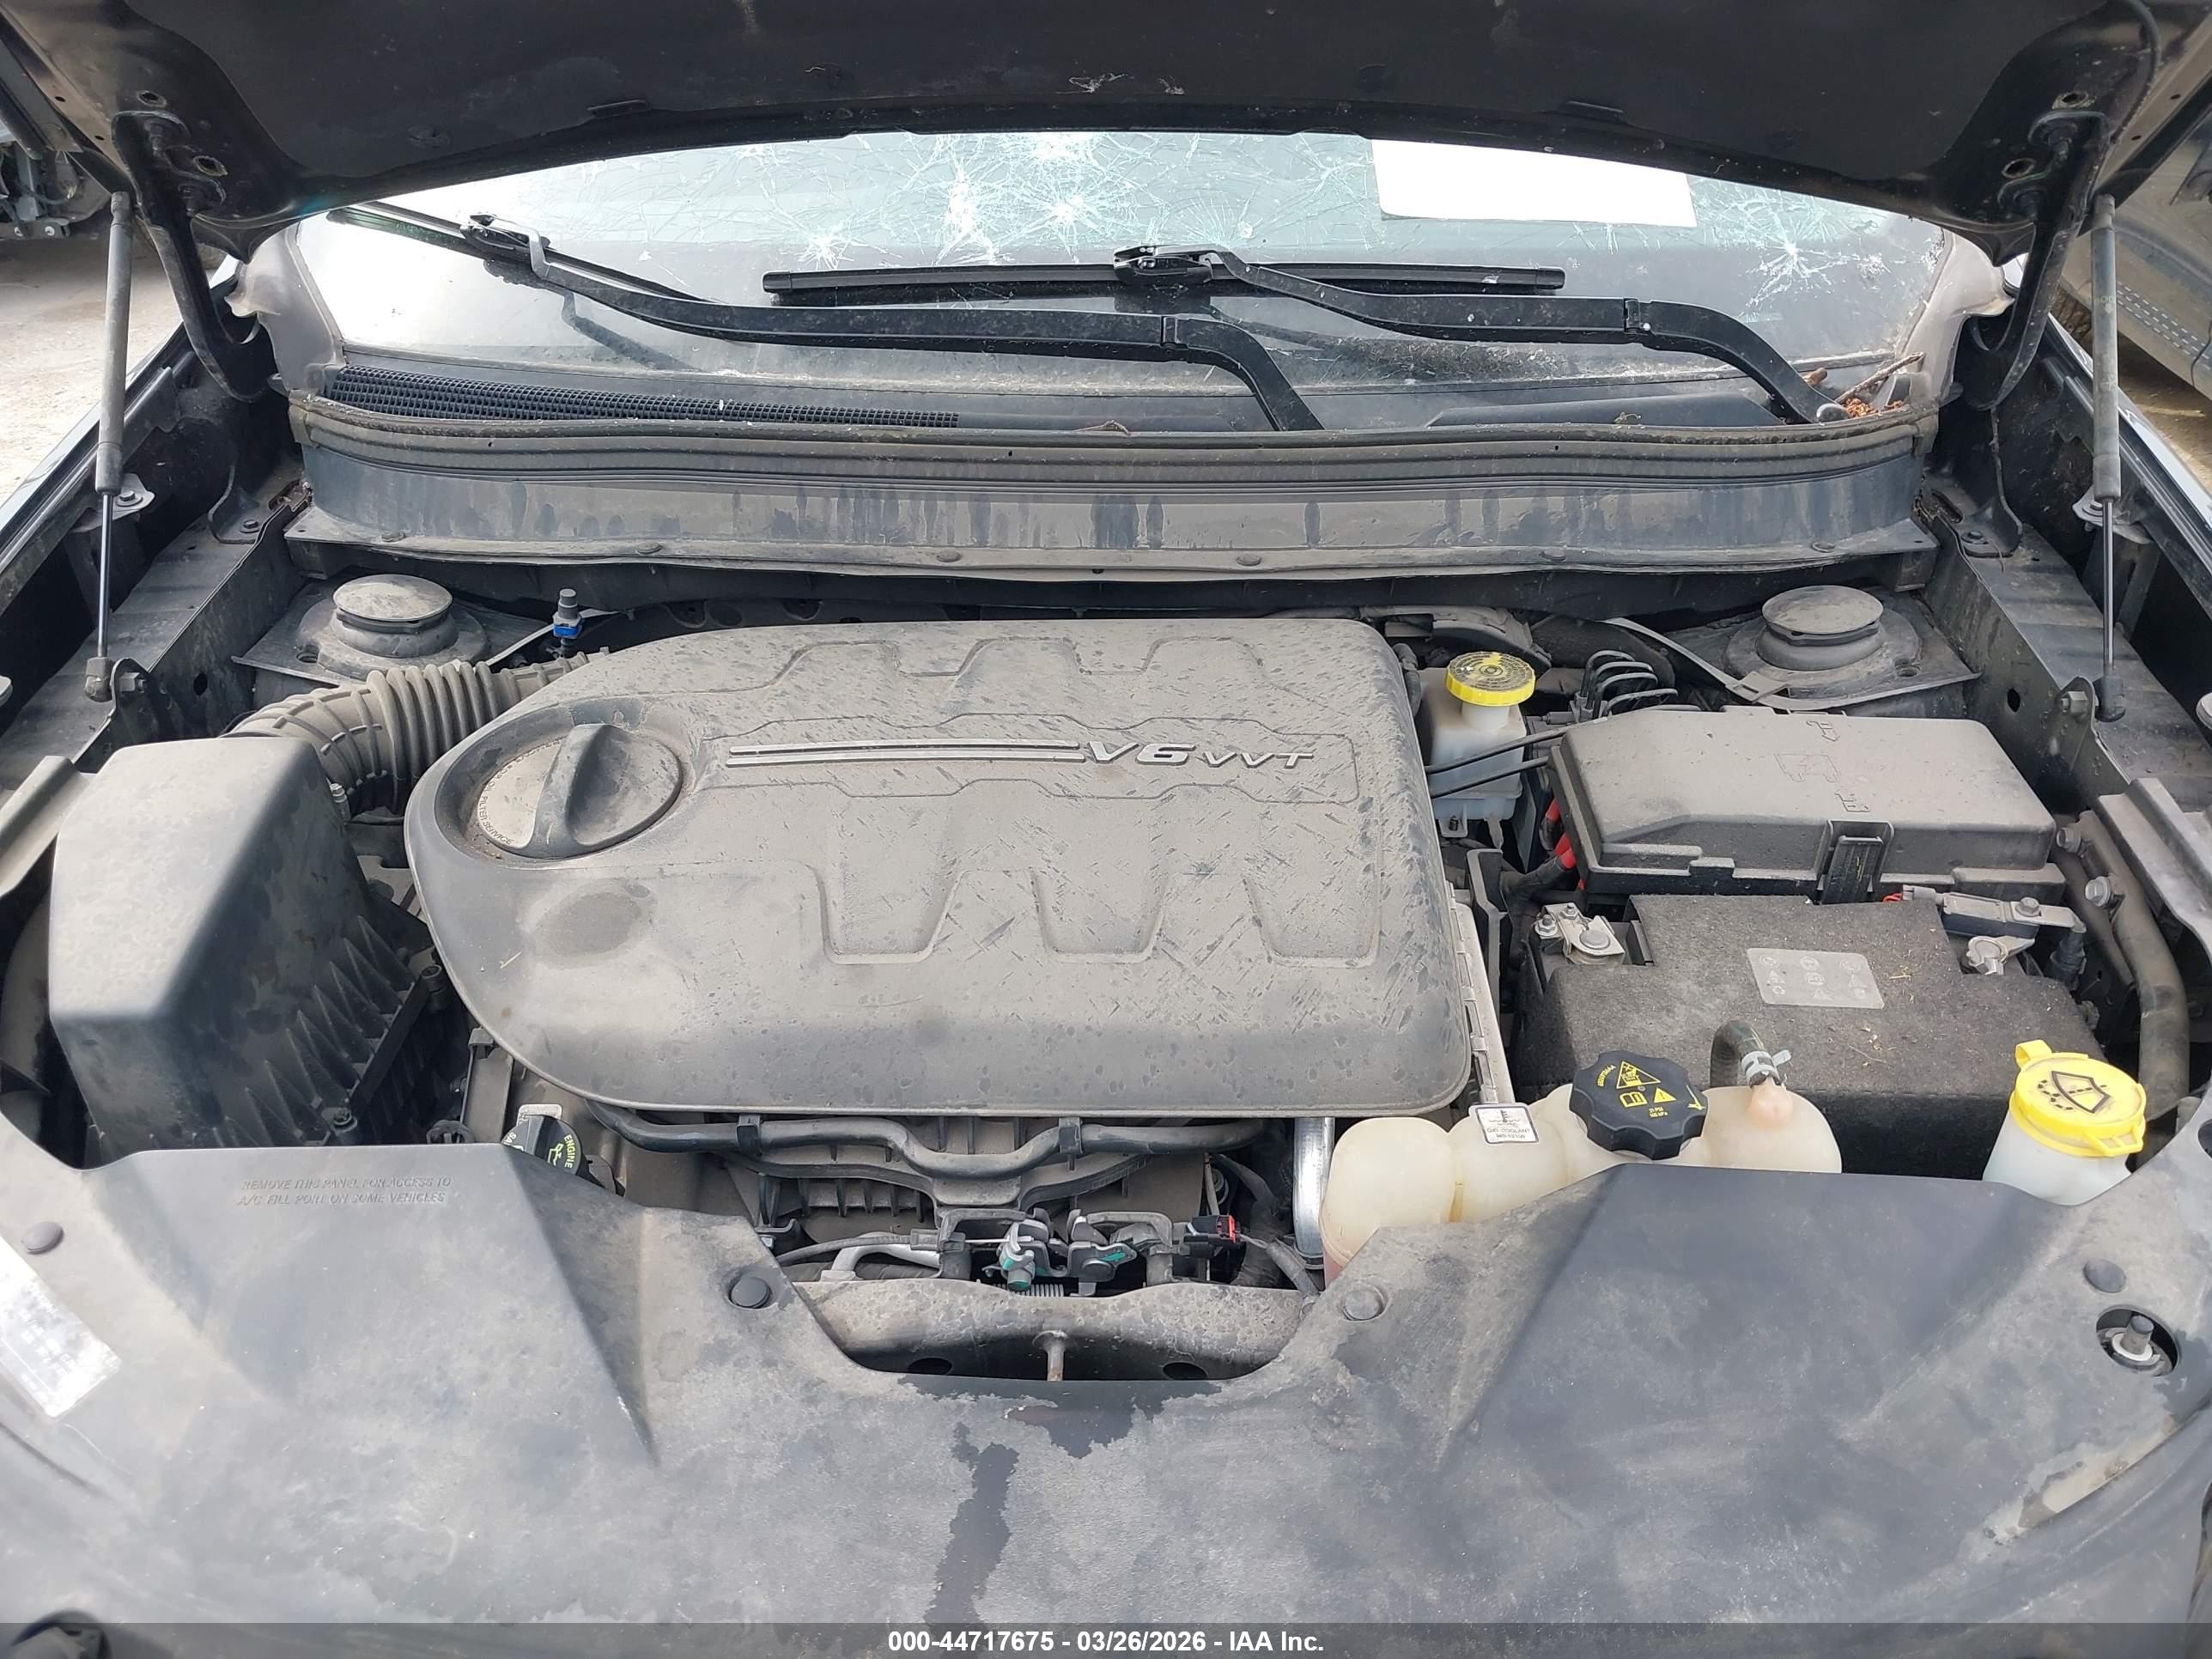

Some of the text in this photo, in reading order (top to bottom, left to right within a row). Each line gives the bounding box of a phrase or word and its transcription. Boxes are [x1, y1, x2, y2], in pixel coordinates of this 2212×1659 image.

[1089, 741, 1314, 769] V6 VVT
[478, 795, 489, 820] FILTER
[483, 820, 515, 845] SERVICE
[563, 1134, 576, 1169] ENGINE
[240, 1176, 452, 1190] REMOVE THIS PANEL FOR ACCESS TO
[237, 1191, 447, 1206] A/C FILL PORT ON SOME VEHICLES
